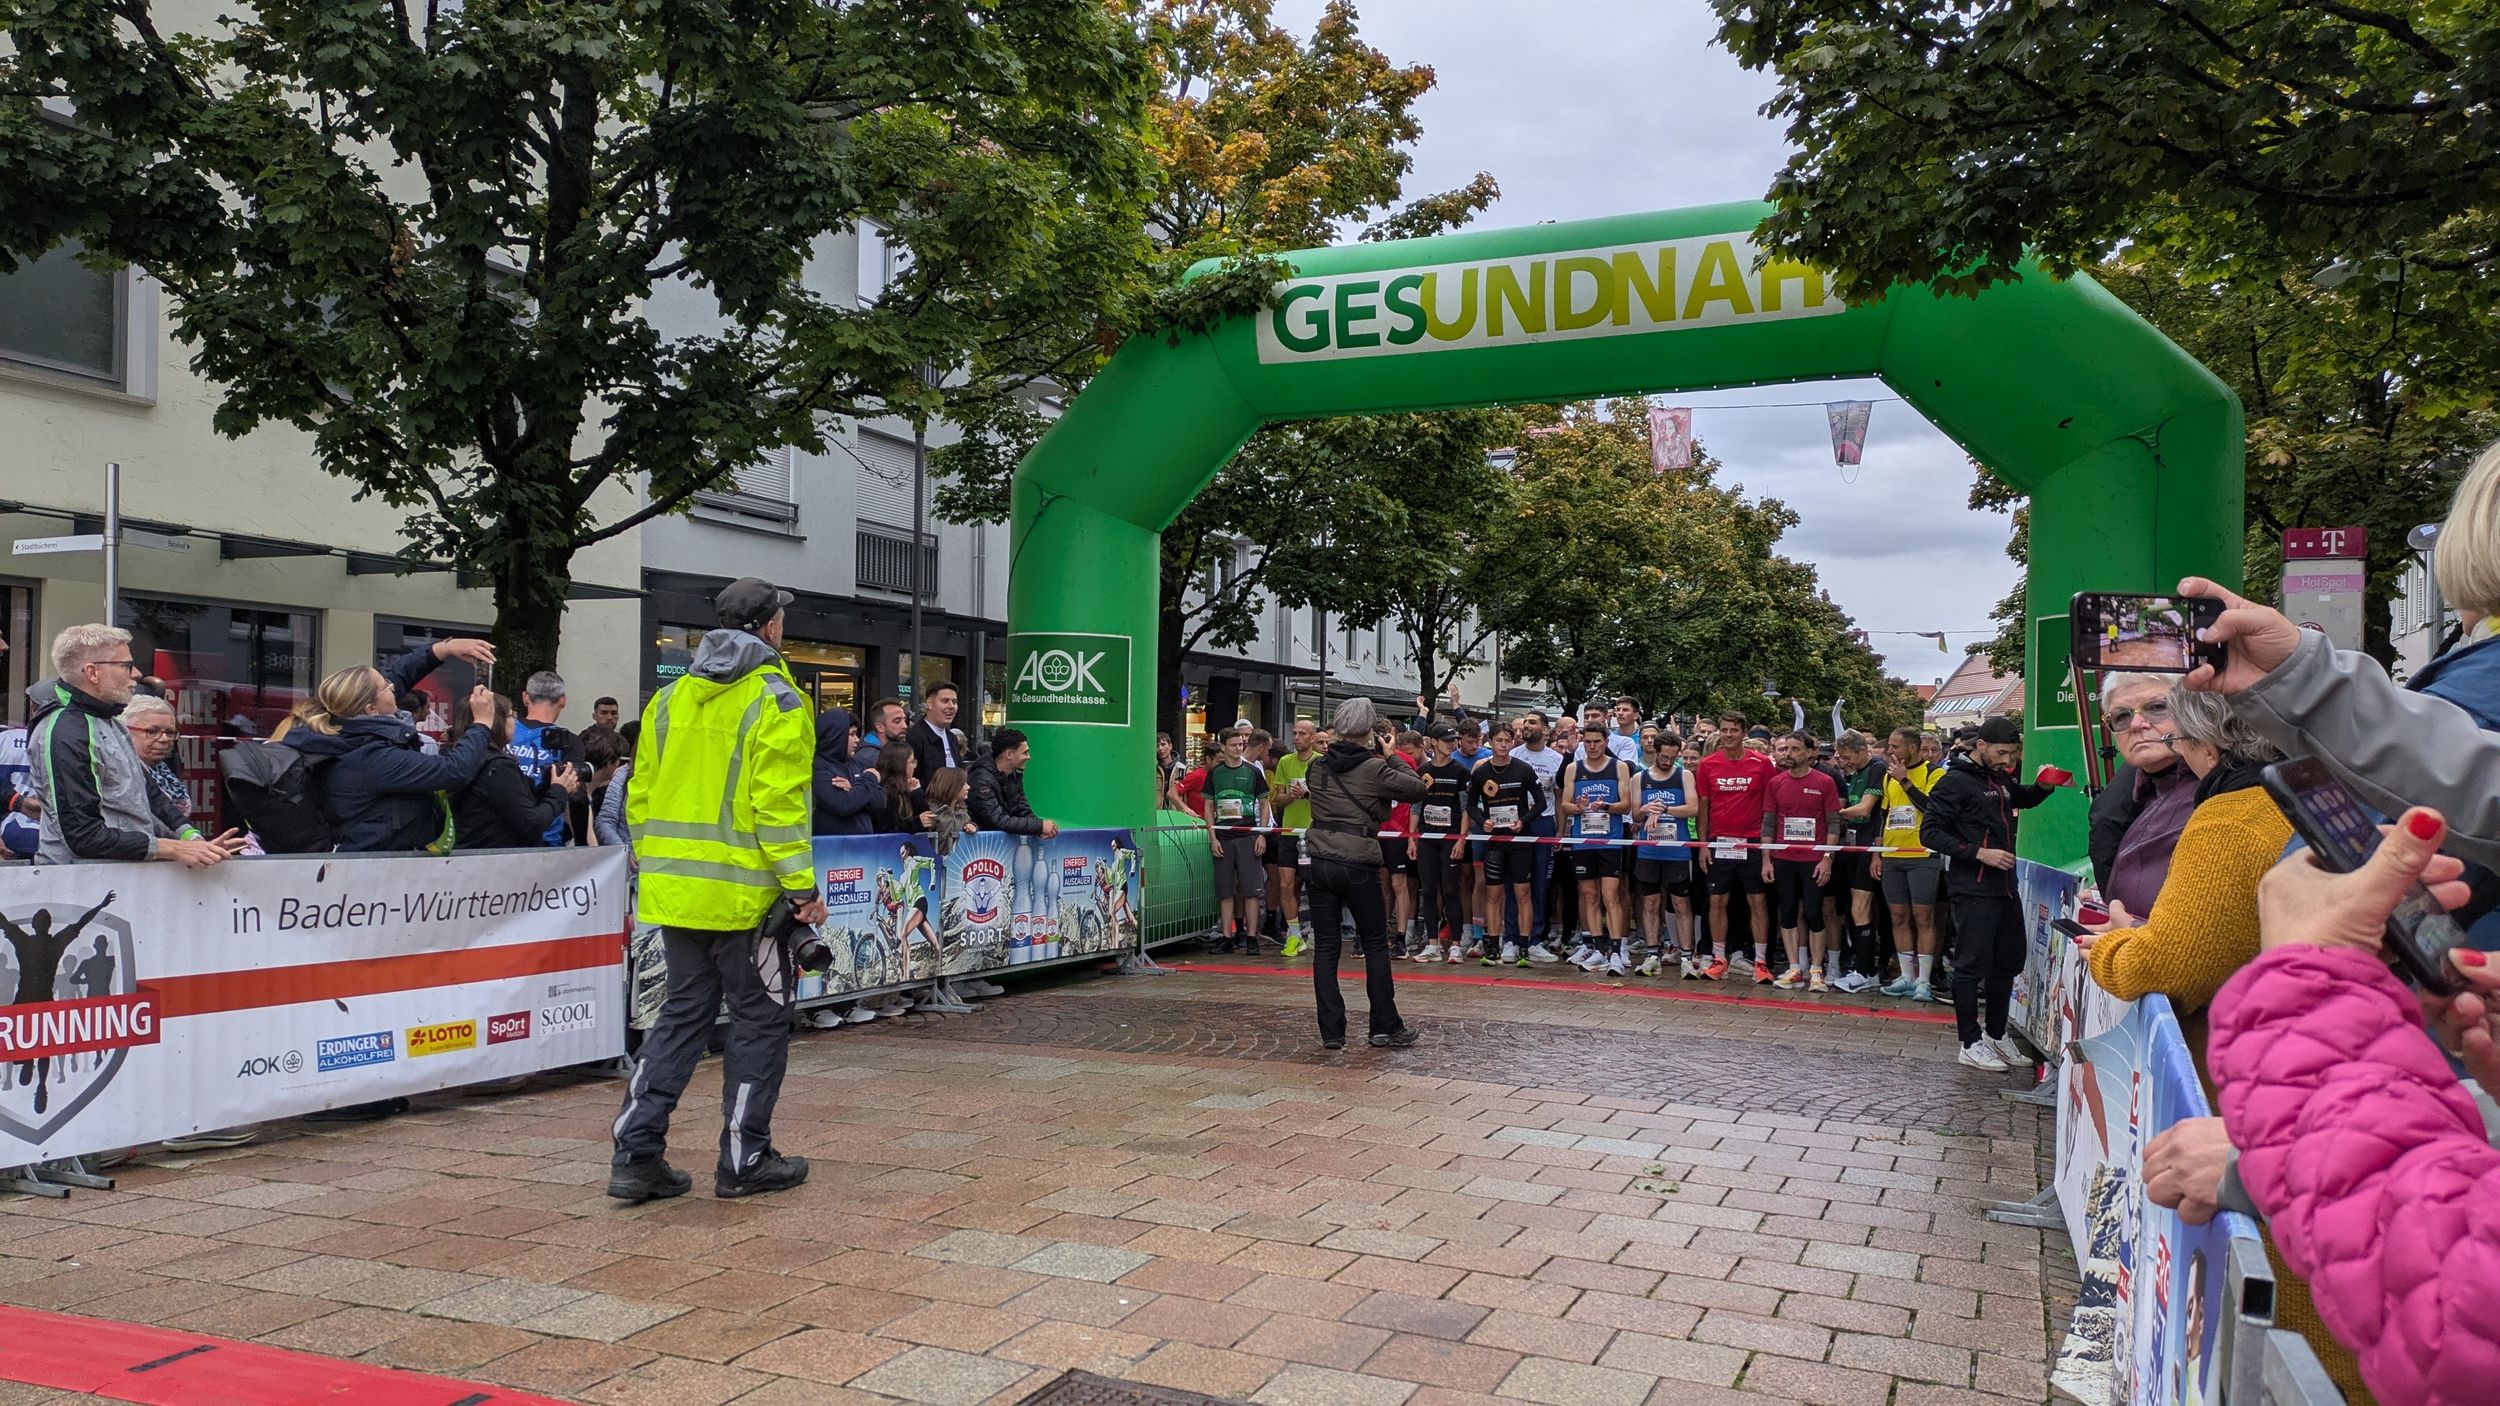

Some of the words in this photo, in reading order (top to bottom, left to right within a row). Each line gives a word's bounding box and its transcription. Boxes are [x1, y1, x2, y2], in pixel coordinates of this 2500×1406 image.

[20, 541, 58, 551] Stadtbücherei
[168, 540, 186, 549] Bahnhof
[2302, 576, 2346, 589] HotSpot
[1013, 649, 1106, 692] AOK
[1011, 693, 1021, 703] Die
[1021, 693, 1108, 705] Gesundheitskasse.
[2057, 691, 2075, 703] Die
[179, 737, 217, 770] ALE
[1785, 828, 1812, 837] Richard
[1064, 857, 1086, 867] ENERGIE
[829, 869, 861, 881] ENERGIE
[966, 860, 1001, 879] APOLLO
[1064, 868, 1081, 877] KRAFT
[829, 882, 853, 892] KRAFT
[1064, 877, 1091, 886] AUSDAUER
[828, 892, 870, 905] AUSDAUER
[232, 898, 261, 934] in
[278, 879, 599, 931] Baden-Württemberg!
[960, 927, 1002, 947] SPORT
[541, 1003, 593, 1027] S.COOL
[0, 1001, 151, 1051] RUNNING
[490, 1018, 526, 1034] SpOrt
[429, 1024, 473, 1043] LOTTO
[318, 1036, 379, 1057] ERDINGER
[319, 1049, 393, 1068] ALKOHOLFREI
[237, 1055, 280, 1078] AOK
